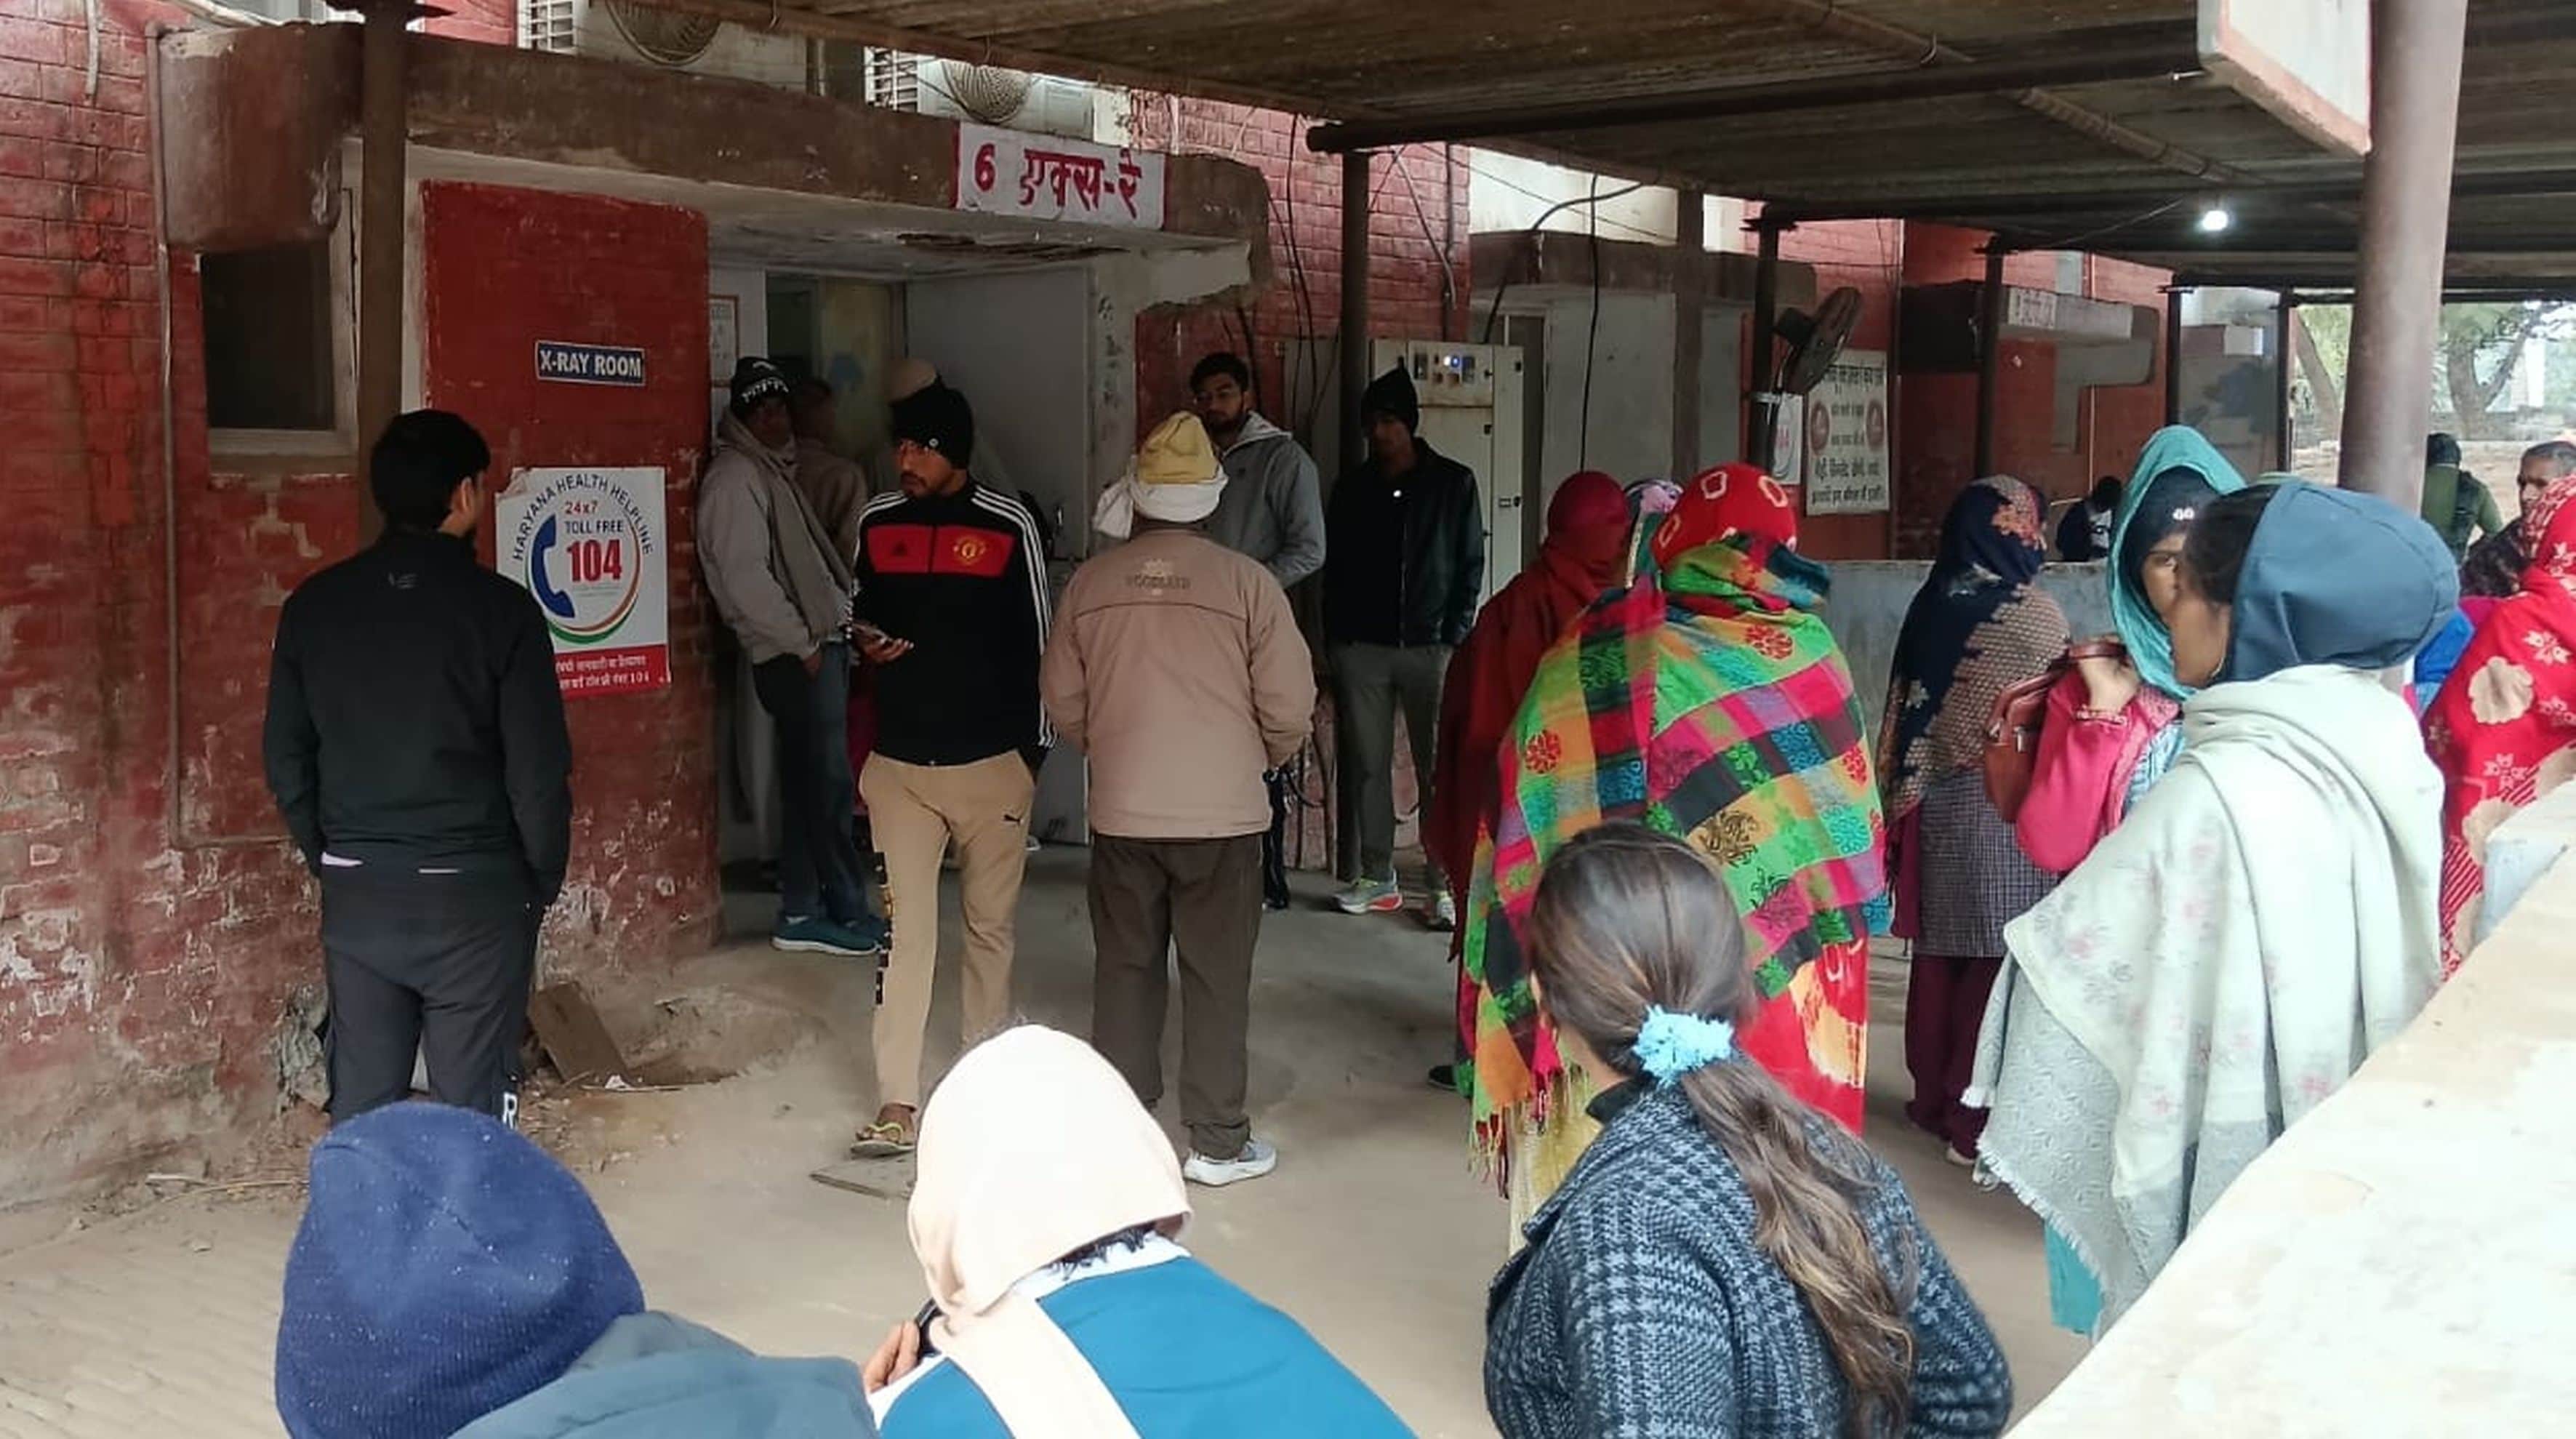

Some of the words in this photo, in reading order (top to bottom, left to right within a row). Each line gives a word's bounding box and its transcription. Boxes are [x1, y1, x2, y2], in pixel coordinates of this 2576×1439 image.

[974, 143, 996, 192] 6
[540, 350, 589, 373] X-RAY
[595, 355, 641, 377] ROOM
[512, 487, 556, 561] HARYANA
[555, 473, 608, 494] HEALTH
[610, 484, 654, 556] HELPLINE
[564, 520, 592, 534] TOLL
[596, 519, 624, 533] FREE
[567, 539, 622, 582] 104
